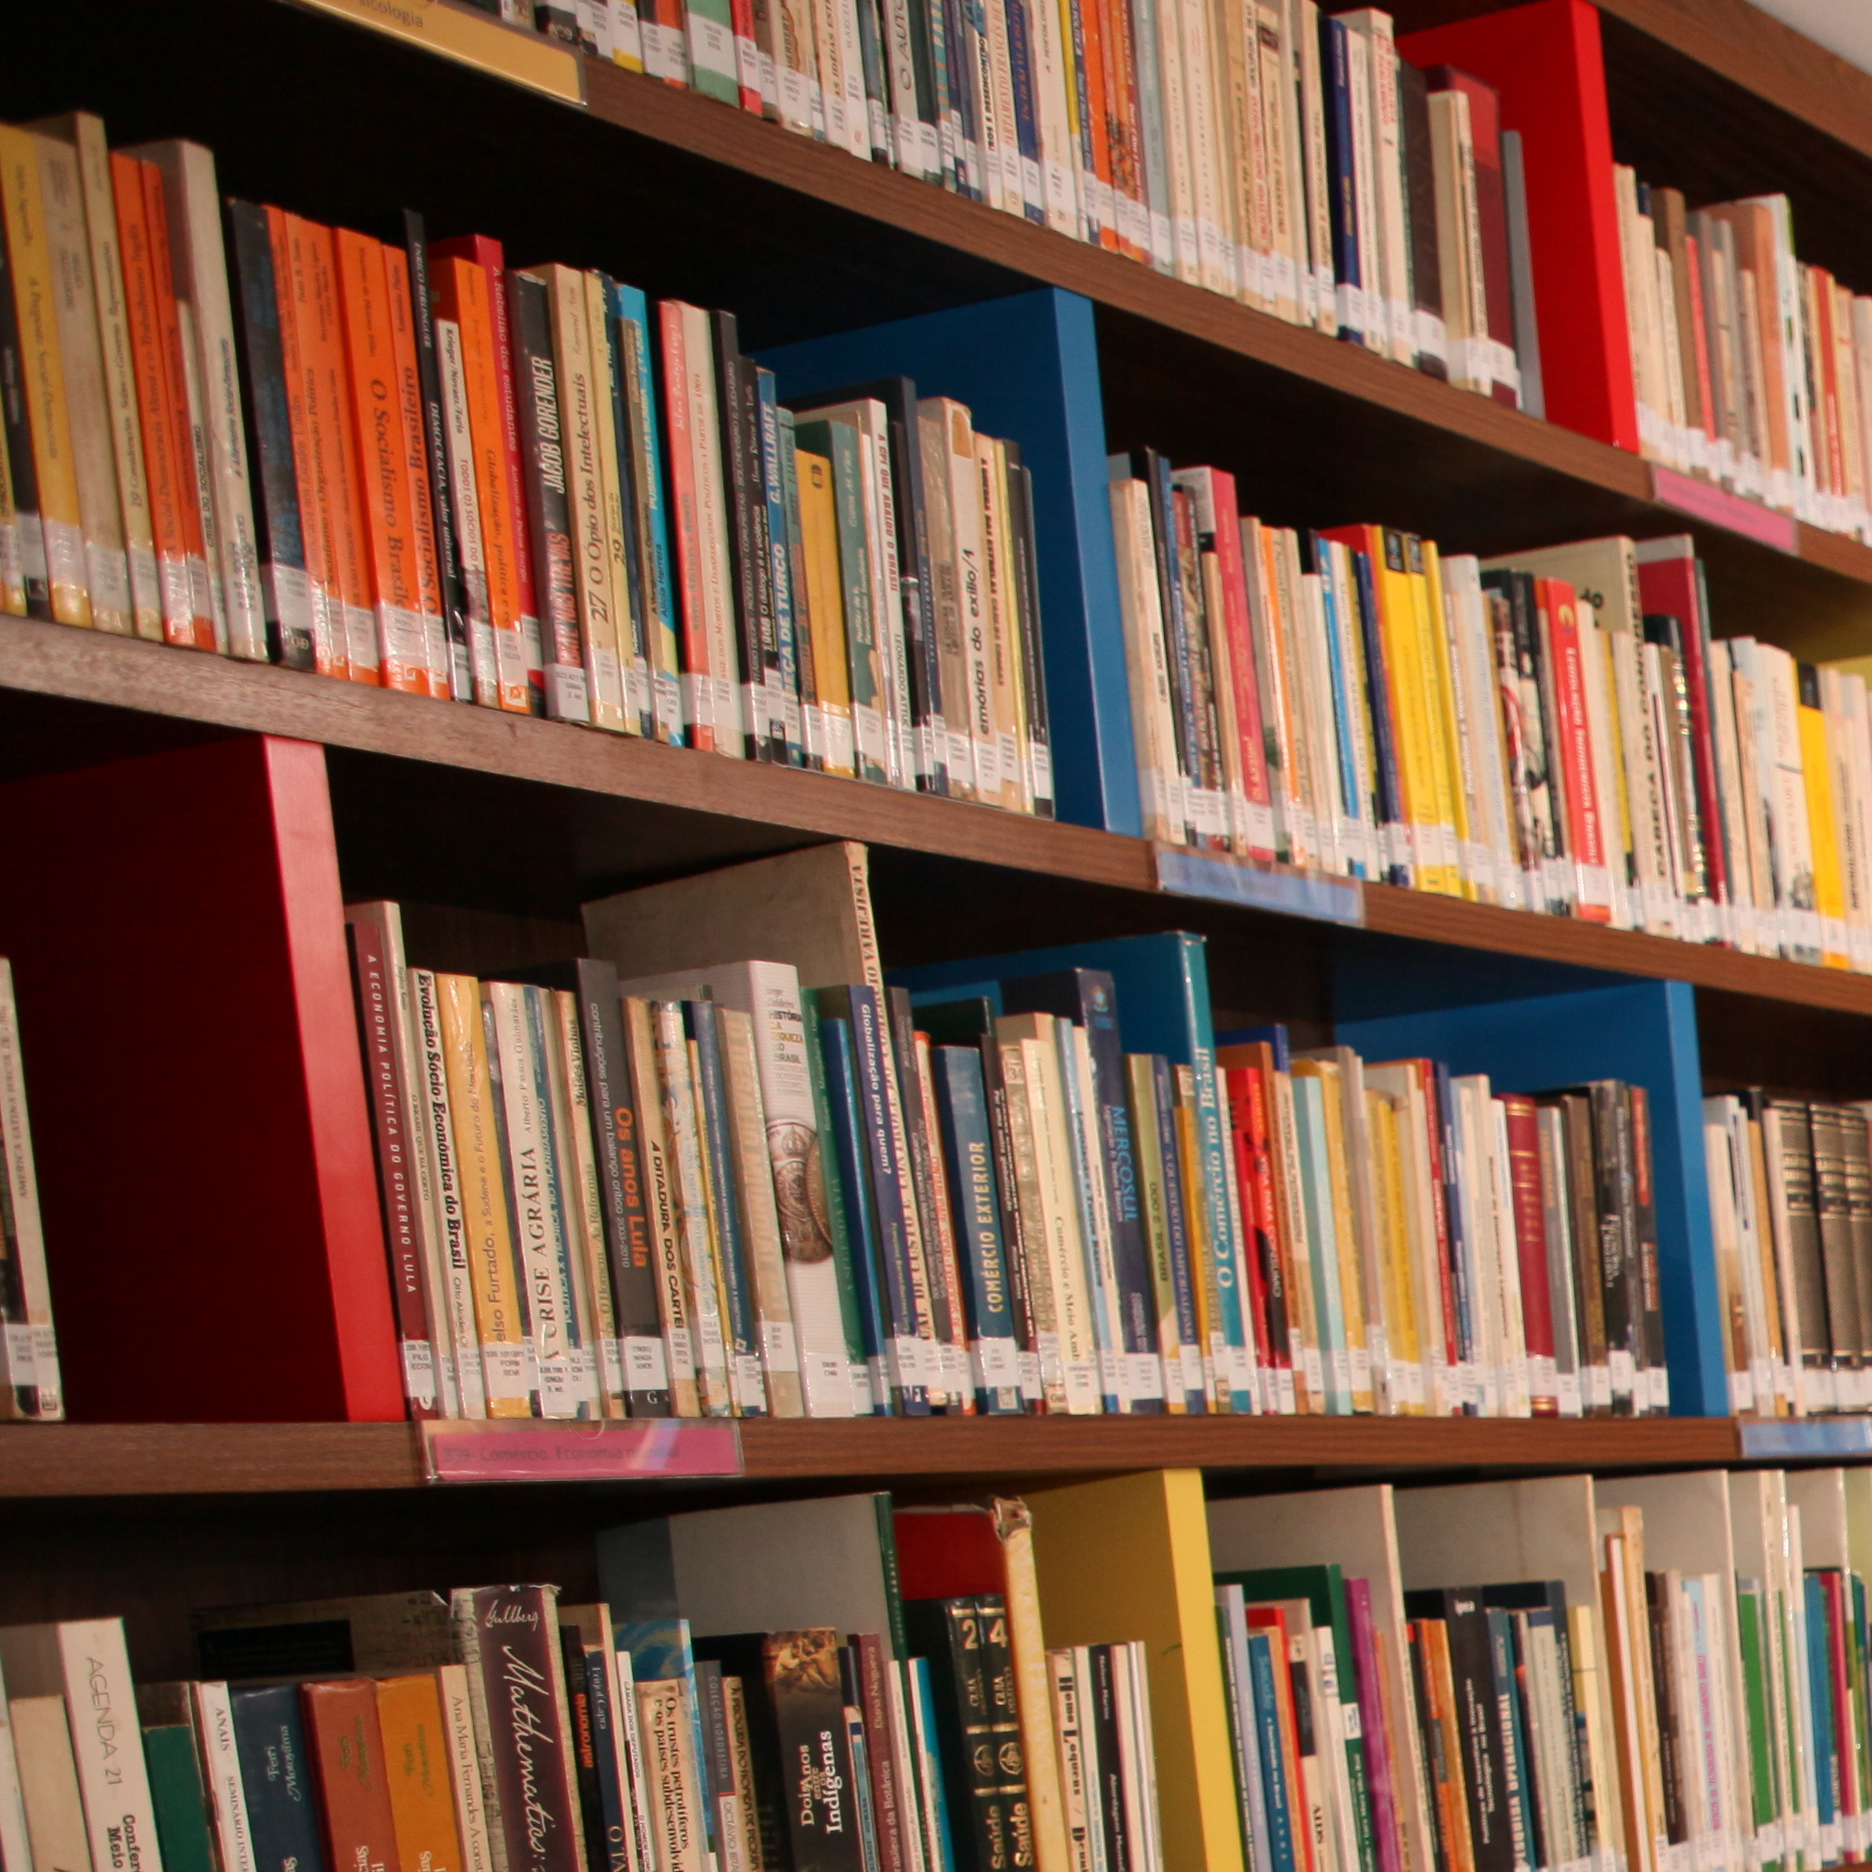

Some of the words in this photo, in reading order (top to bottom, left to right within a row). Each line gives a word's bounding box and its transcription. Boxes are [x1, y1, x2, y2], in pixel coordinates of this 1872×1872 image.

[371, 378, 386, 400] O
[531, 356, 559, 434] GORENDER
[402, 366, 426, 470] Brasileiro
[575, 373, 592, 476] Intelectuais
[373, 405, 398, 528] Socialismo
[540, 434, 565, 494] JACOB
[583, 480, 597, 513] dos
[412, 477, 437, 590] Socialismo
[582, 514, 603, 560] Ópio
[589, 562, 603, 581] O
[774, 543, 789, 612] TURCO
[889, 552, 898, 592] BRASIL
[424, 597, 437, 615] O
[589, 591, 609, 623] 27
[778, 616, 791, 638] DE
[972, 630, 981, 652] do
[367, 954, 377, 963] A
[369, 969, 386, 1053] ECONOMIA
[417, 973, 436, 1048] Evolução
[860, 1003, 879, 1092] Globalização
[380, 1062, 398, 1136] POLÍTICA
[1194, 1046, 1218, 1113] Brasil
[615, 1107, 634, 1141] Os
[872, 1093, 885, 1123] para
[1207, 1116, 1222, 1145] no
[390, 1143, 400, 1163] DO
[875, 1123, 893, 1176] quem?
[1113, 1106, 1138, 1219] MERCOSUL
[618, 1147, 640, 1207] anos
[967, 1141, 987, 1225] EXTERIOR
[393, 1170, 410, 1244] GOVERNO
[443, 1196, 457, 1215] do
[523, 1147, 548, 1258] AGRÁRIA
[1208, 1152, 1231, 1261] Comércio
[447, 1218, 467, 1270] Brasil
[482, 1227, 502, 1301] Furtado,
[627, 1213, 648, 1268] Lula
[403, 1253, 416, 1293] LULA
[978, 1232, 1003, 1313] COMÉRCIO
[1217, 1264, 1234, 1290] O
[961, 1619, 977, 1649] 2
[989, 1619, 1008, 1649] 4
[86, 1657, 119, 1760] AGENDA
[104, 1767, 123, 1785] 21
[215, 1706, 231, 1752] ANAIS
[655, 1710, 664, 1725] os
[664, 1697, 676, 1715] Os
[655, 1727, 669, 1769] países
[666, 1719, 682, 1768] trustes
[799, 1746, 810, 1787] Anos
[819, 1730, 844, 1835] Indígenas
[880, 1760, 895, 1805] Botânica
[609, 1826, 621, 1840] O
[671, 1769, 689, 1850] petrolíferos
[799, 1792, 816, 1827] Dois
[1009, 1801, 1033, 1866] Saúde
[106, 1826, 123, 1869] Meio
[985, 1805, 1006, 1869] Saúde
